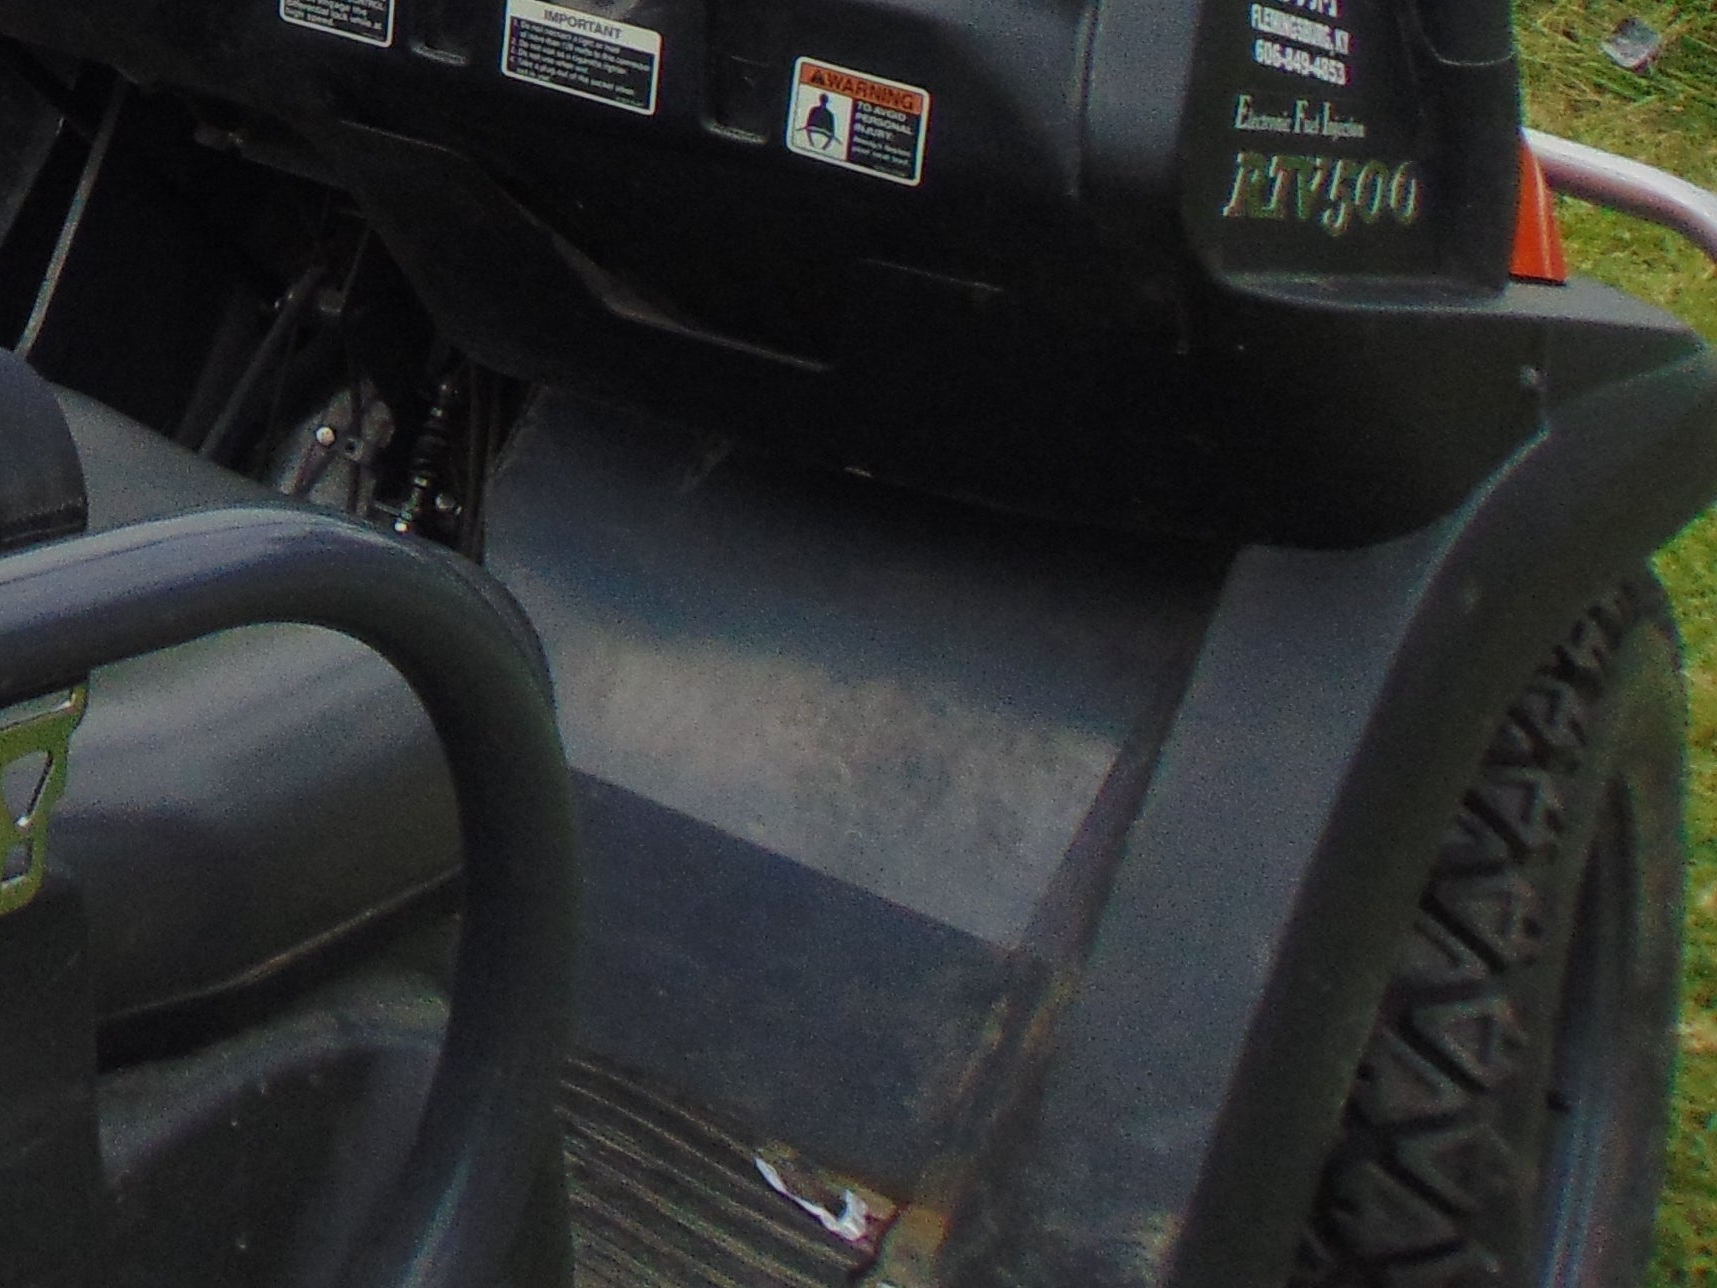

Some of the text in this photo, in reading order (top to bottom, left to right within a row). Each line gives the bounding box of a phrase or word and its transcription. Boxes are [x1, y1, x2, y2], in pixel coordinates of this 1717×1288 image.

[543, 8, 622, 40] IMPORTANT
[825, 72, 914, 110] WARNING
[854, 111, 912, 135] PERSONAL
[856, 101, 906, 122] TO AVOID
[1294, 99, 1320, 134] Fuel
[1322, 101, 1366, 141] Injection
